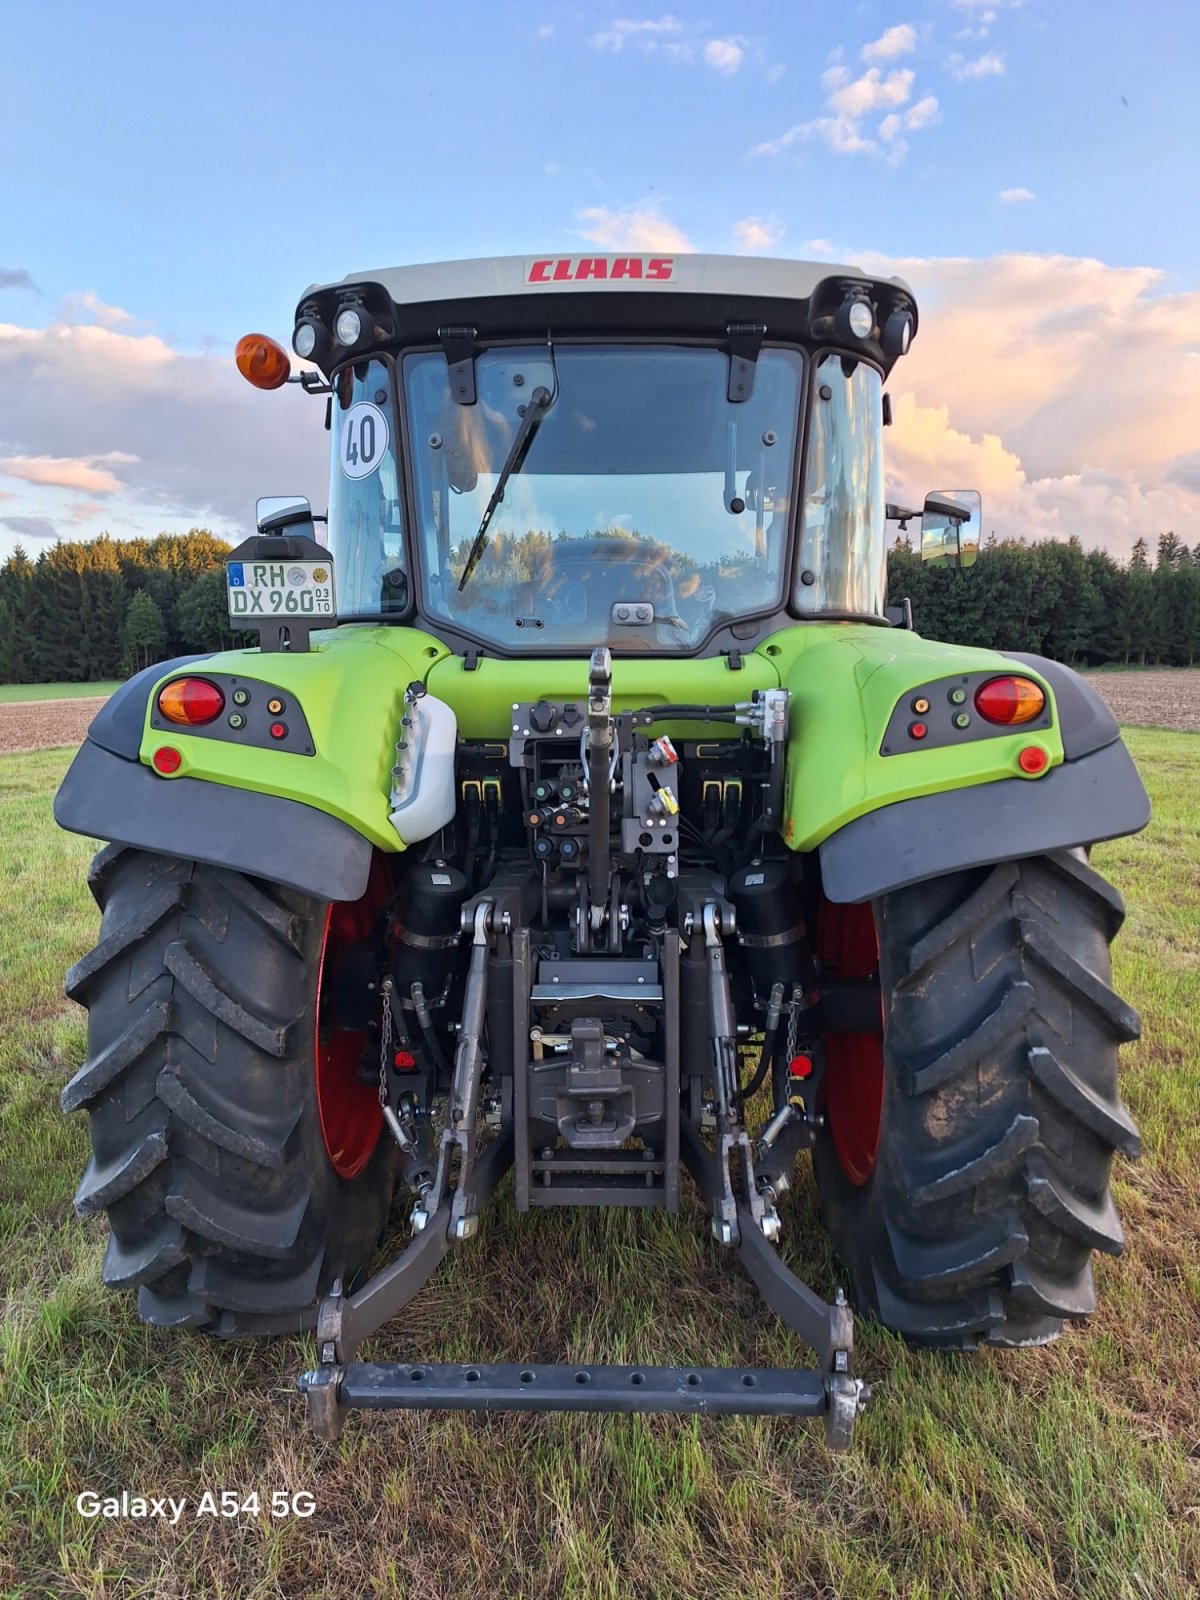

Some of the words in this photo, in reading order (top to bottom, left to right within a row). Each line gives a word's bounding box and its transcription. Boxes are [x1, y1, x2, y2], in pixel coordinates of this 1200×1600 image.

[528, 257, 674, 282] CLAAS
[346, 415, 375, 465] 40
[233, 577, 240, 585] D
[253, 565, 285, 587] RH
[233, 590, 264, 612] DX
[269, 590, 313, 612] 960
[315, 588, 329, 598] 03
[317, 602, 330, 612] 10
